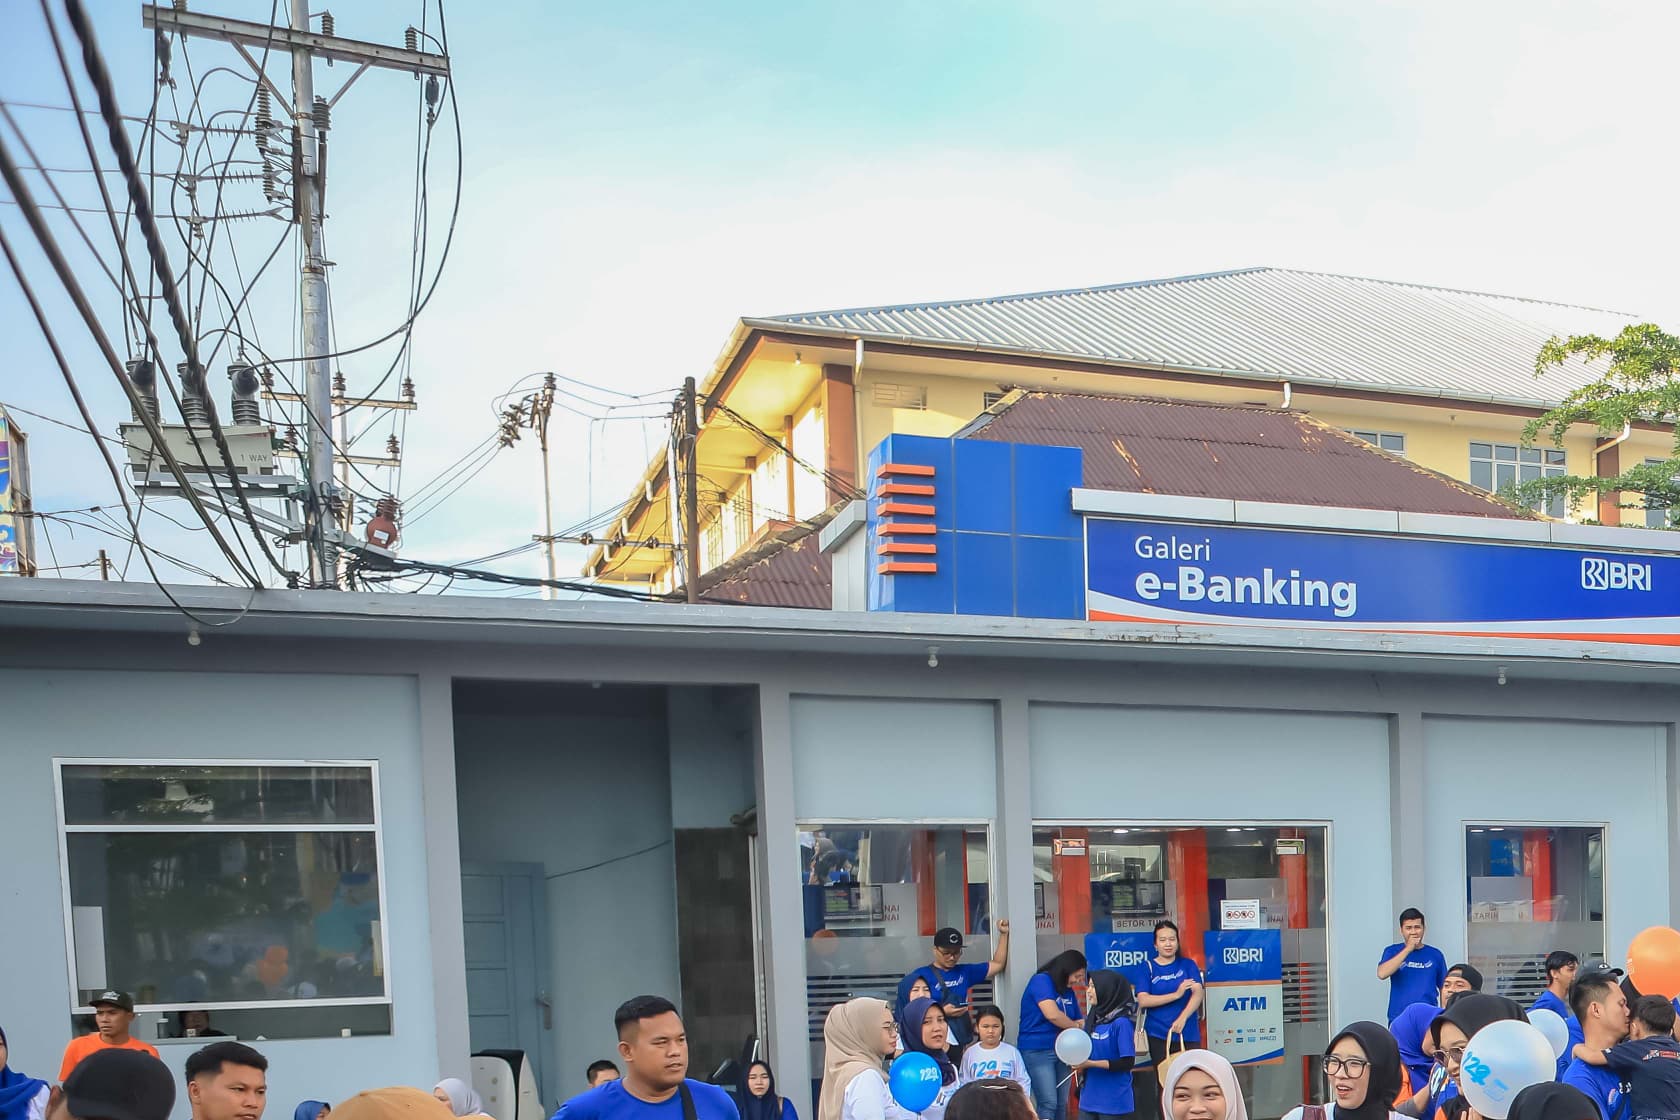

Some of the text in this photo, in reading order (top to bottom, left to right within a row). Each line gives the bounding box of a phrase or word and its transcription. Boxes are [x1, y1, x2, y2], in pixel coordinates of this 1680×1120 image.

[249, 454, 268, 462] WAY
[1134, 535, 1211, 561] Galeri
[1605, 559, 1652, 591] BRI
[1135, 566, 1358, 618] e-Banking
[1119, 951, 1148, 967] BRI
[1237, 947, 1263, 963] BRI
[1223, 996, 1267, 1012] ATM
[1463, 1051, 1491, 1086] 129
